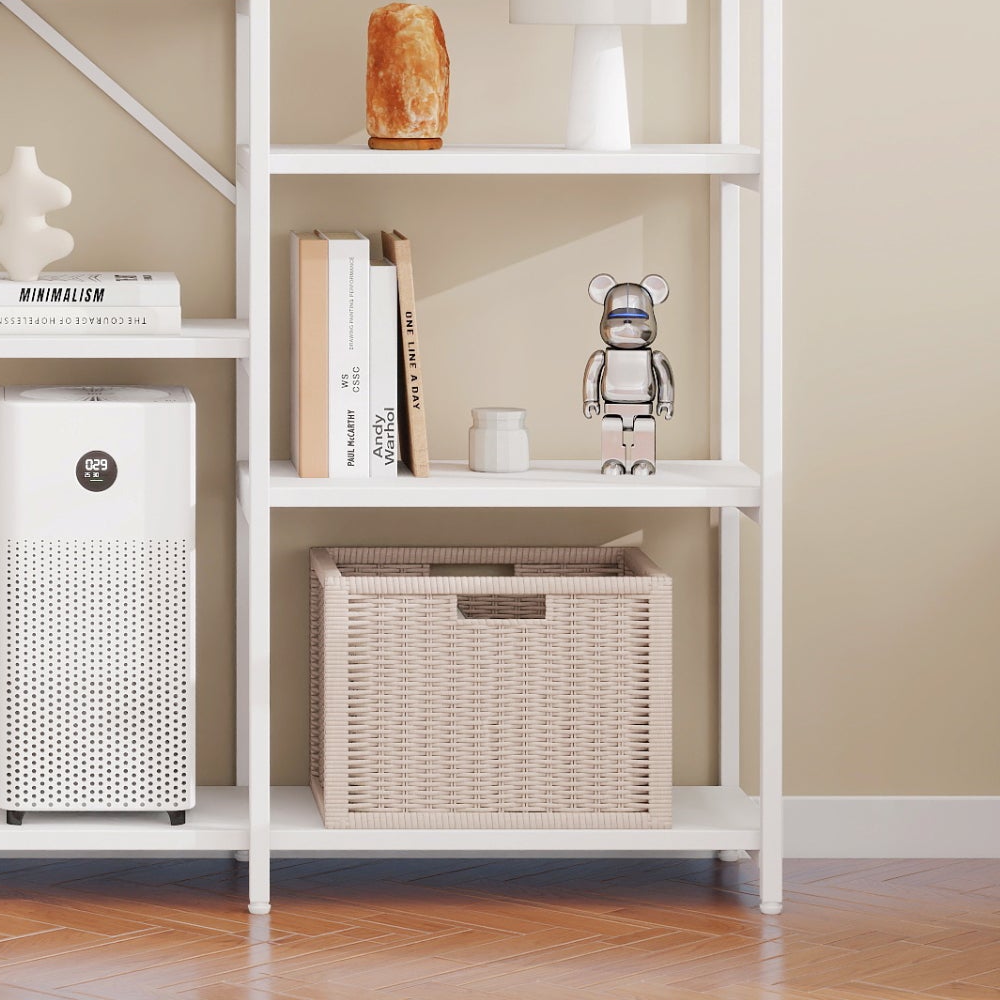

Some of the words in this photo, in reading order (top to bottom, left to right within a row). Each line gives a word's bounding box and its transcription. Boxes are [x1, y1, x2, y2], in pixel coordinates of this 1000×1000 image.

[19, 287, 106, 303] MINIMALISM
[59, 316, 72, 325] OF
[75, 316, 124, 325] COURAGE
[128, 316, 147, 325] THE
[405, 311, 414, 335] ONE
[408, 341, 417, 369] LINE
[341, 373, 349, 389] WS
[352, 366, 361, 393] CSSC
[410, 374, 418, 382] A
[411, 386, 421, 410] DAY
[347, 409, 355, 447] McCARTHY
[372, 414, 386, 458] Andy
[383, 407, 395, 466] Warhol
[85, 458, 108, 471] 029
[347, 448, 355, 467] PAUL
